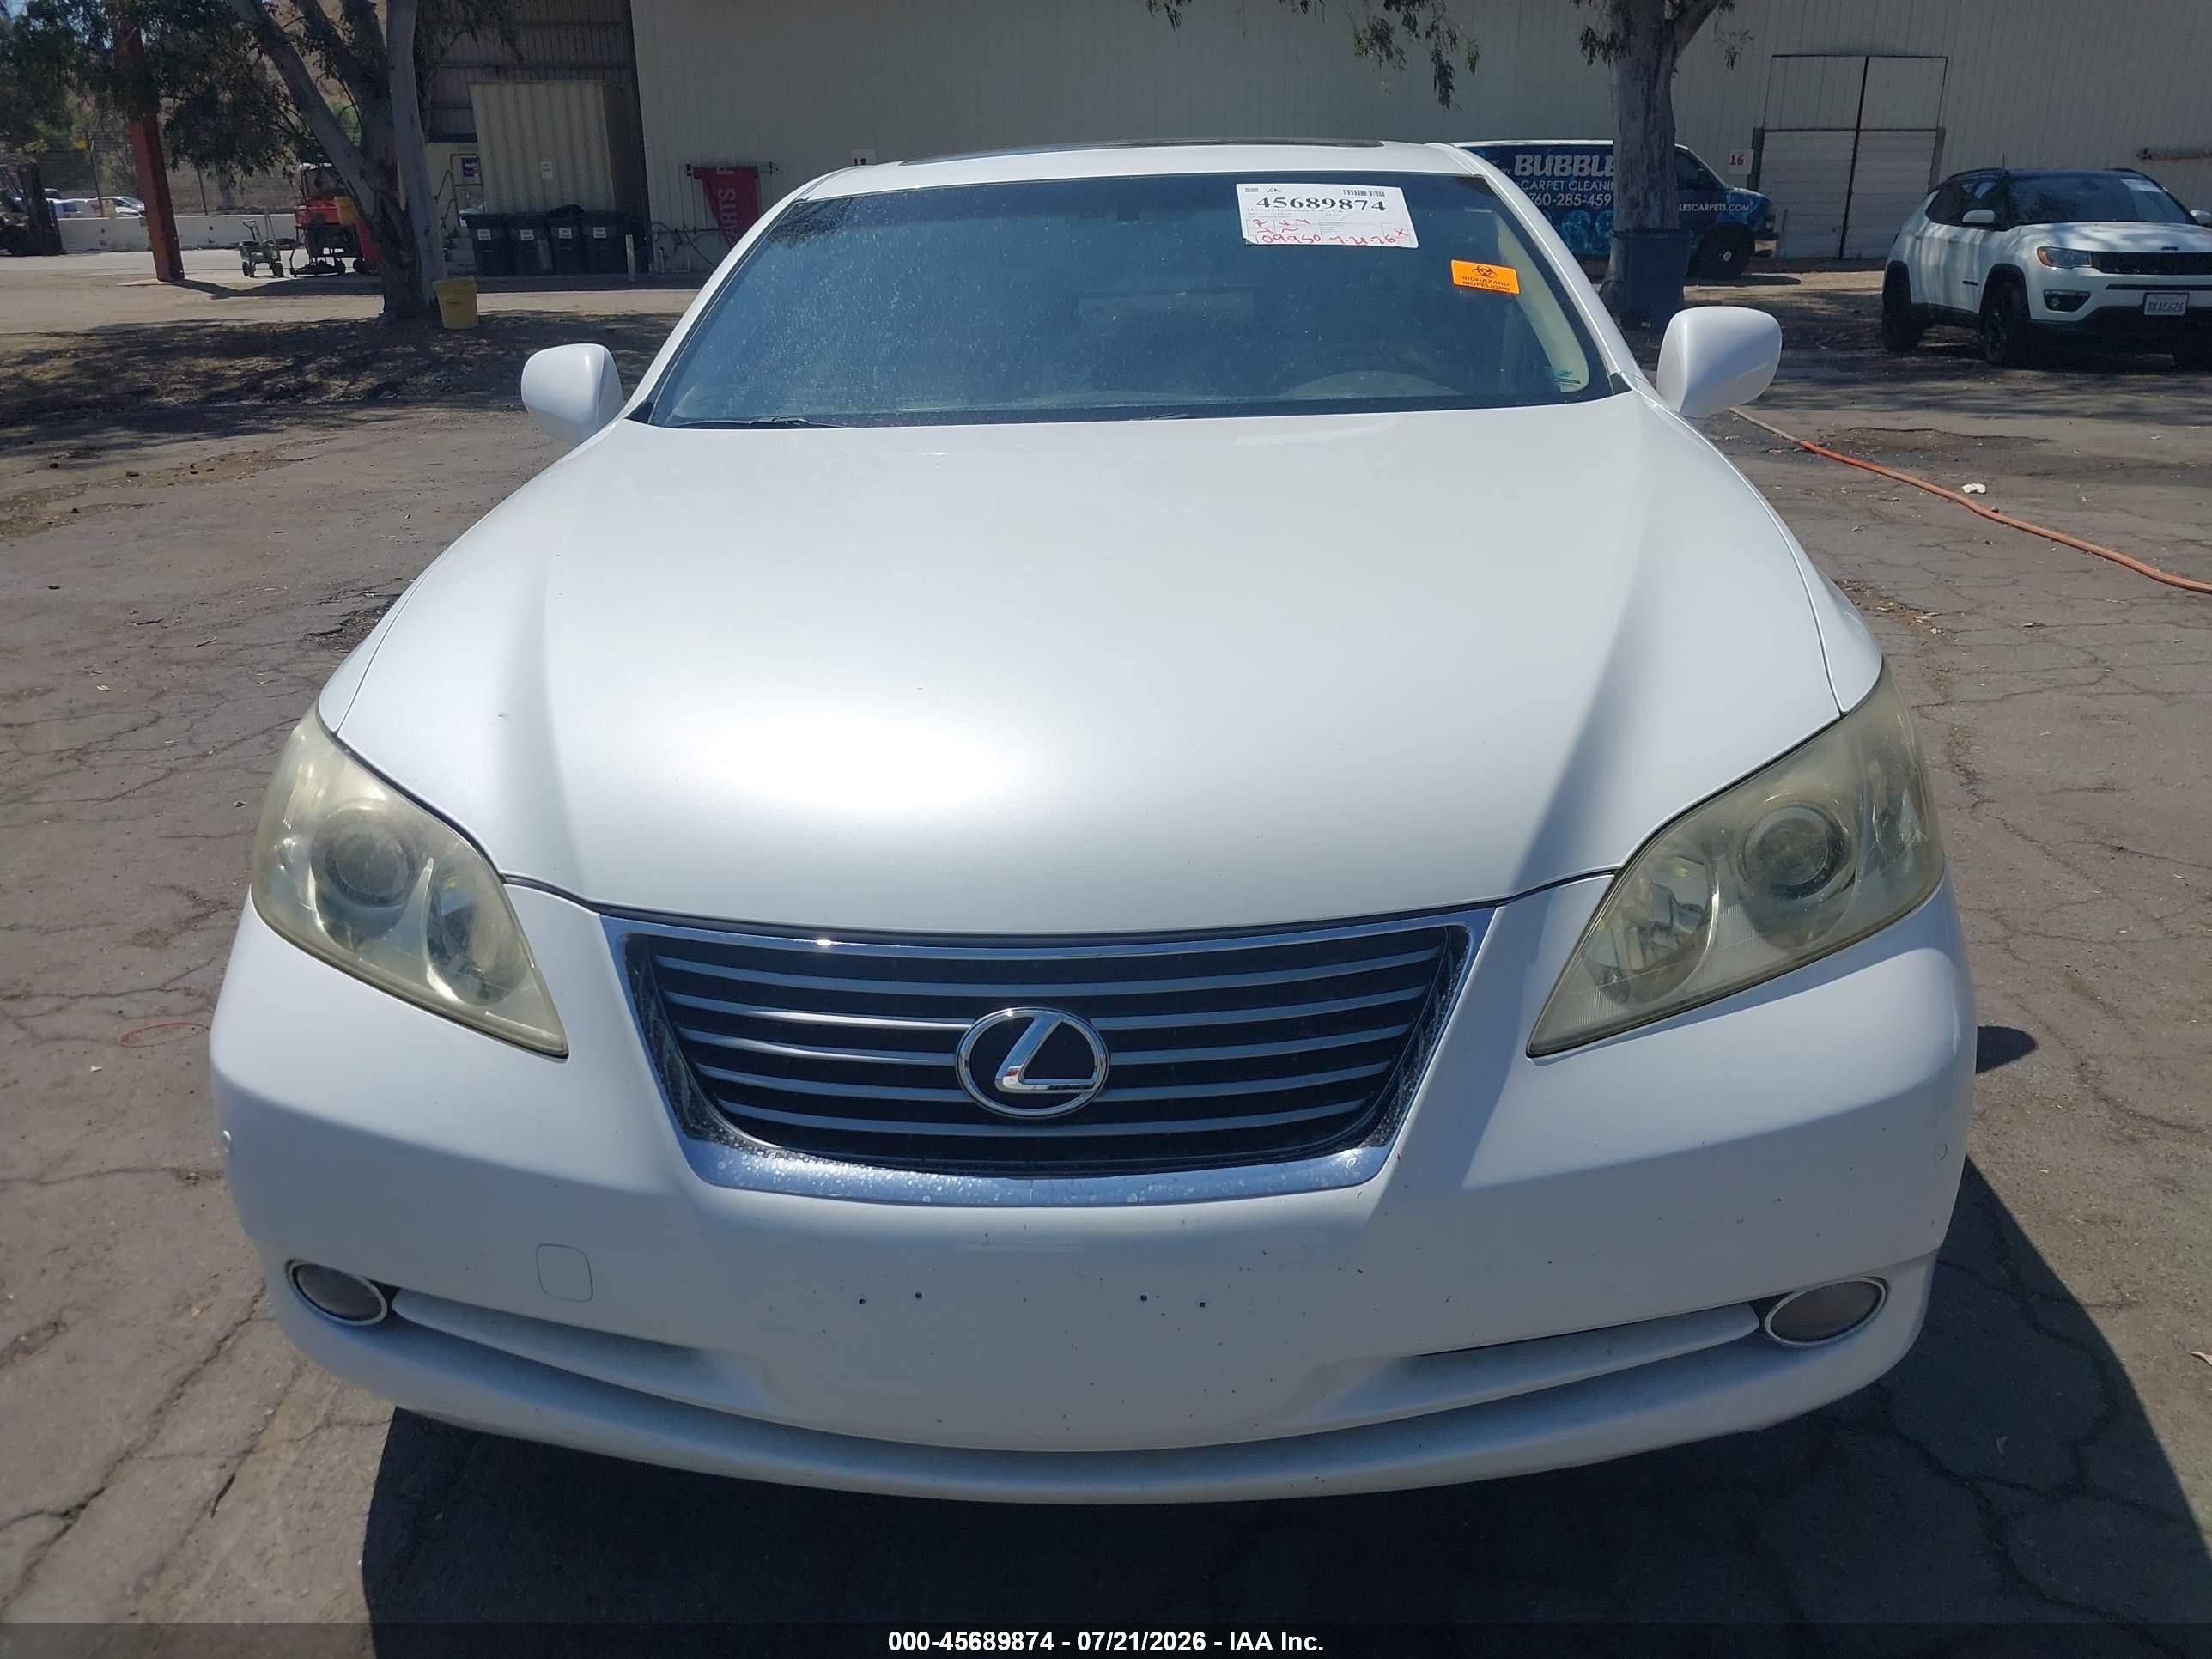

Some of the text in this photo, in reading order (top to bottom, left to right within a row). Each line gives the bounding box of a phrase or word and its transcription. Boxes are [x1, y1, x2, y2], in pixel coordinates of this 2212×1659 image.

[1729, 154, 1745, 166] 16
[1521, 180, 1565, 191] CARPET
[1256, 197, 1386, 211] 45689874
[1529, 193, 1613, 206] 760-285-459
[1462, 276, 1510, 287] BIOHAZARD
